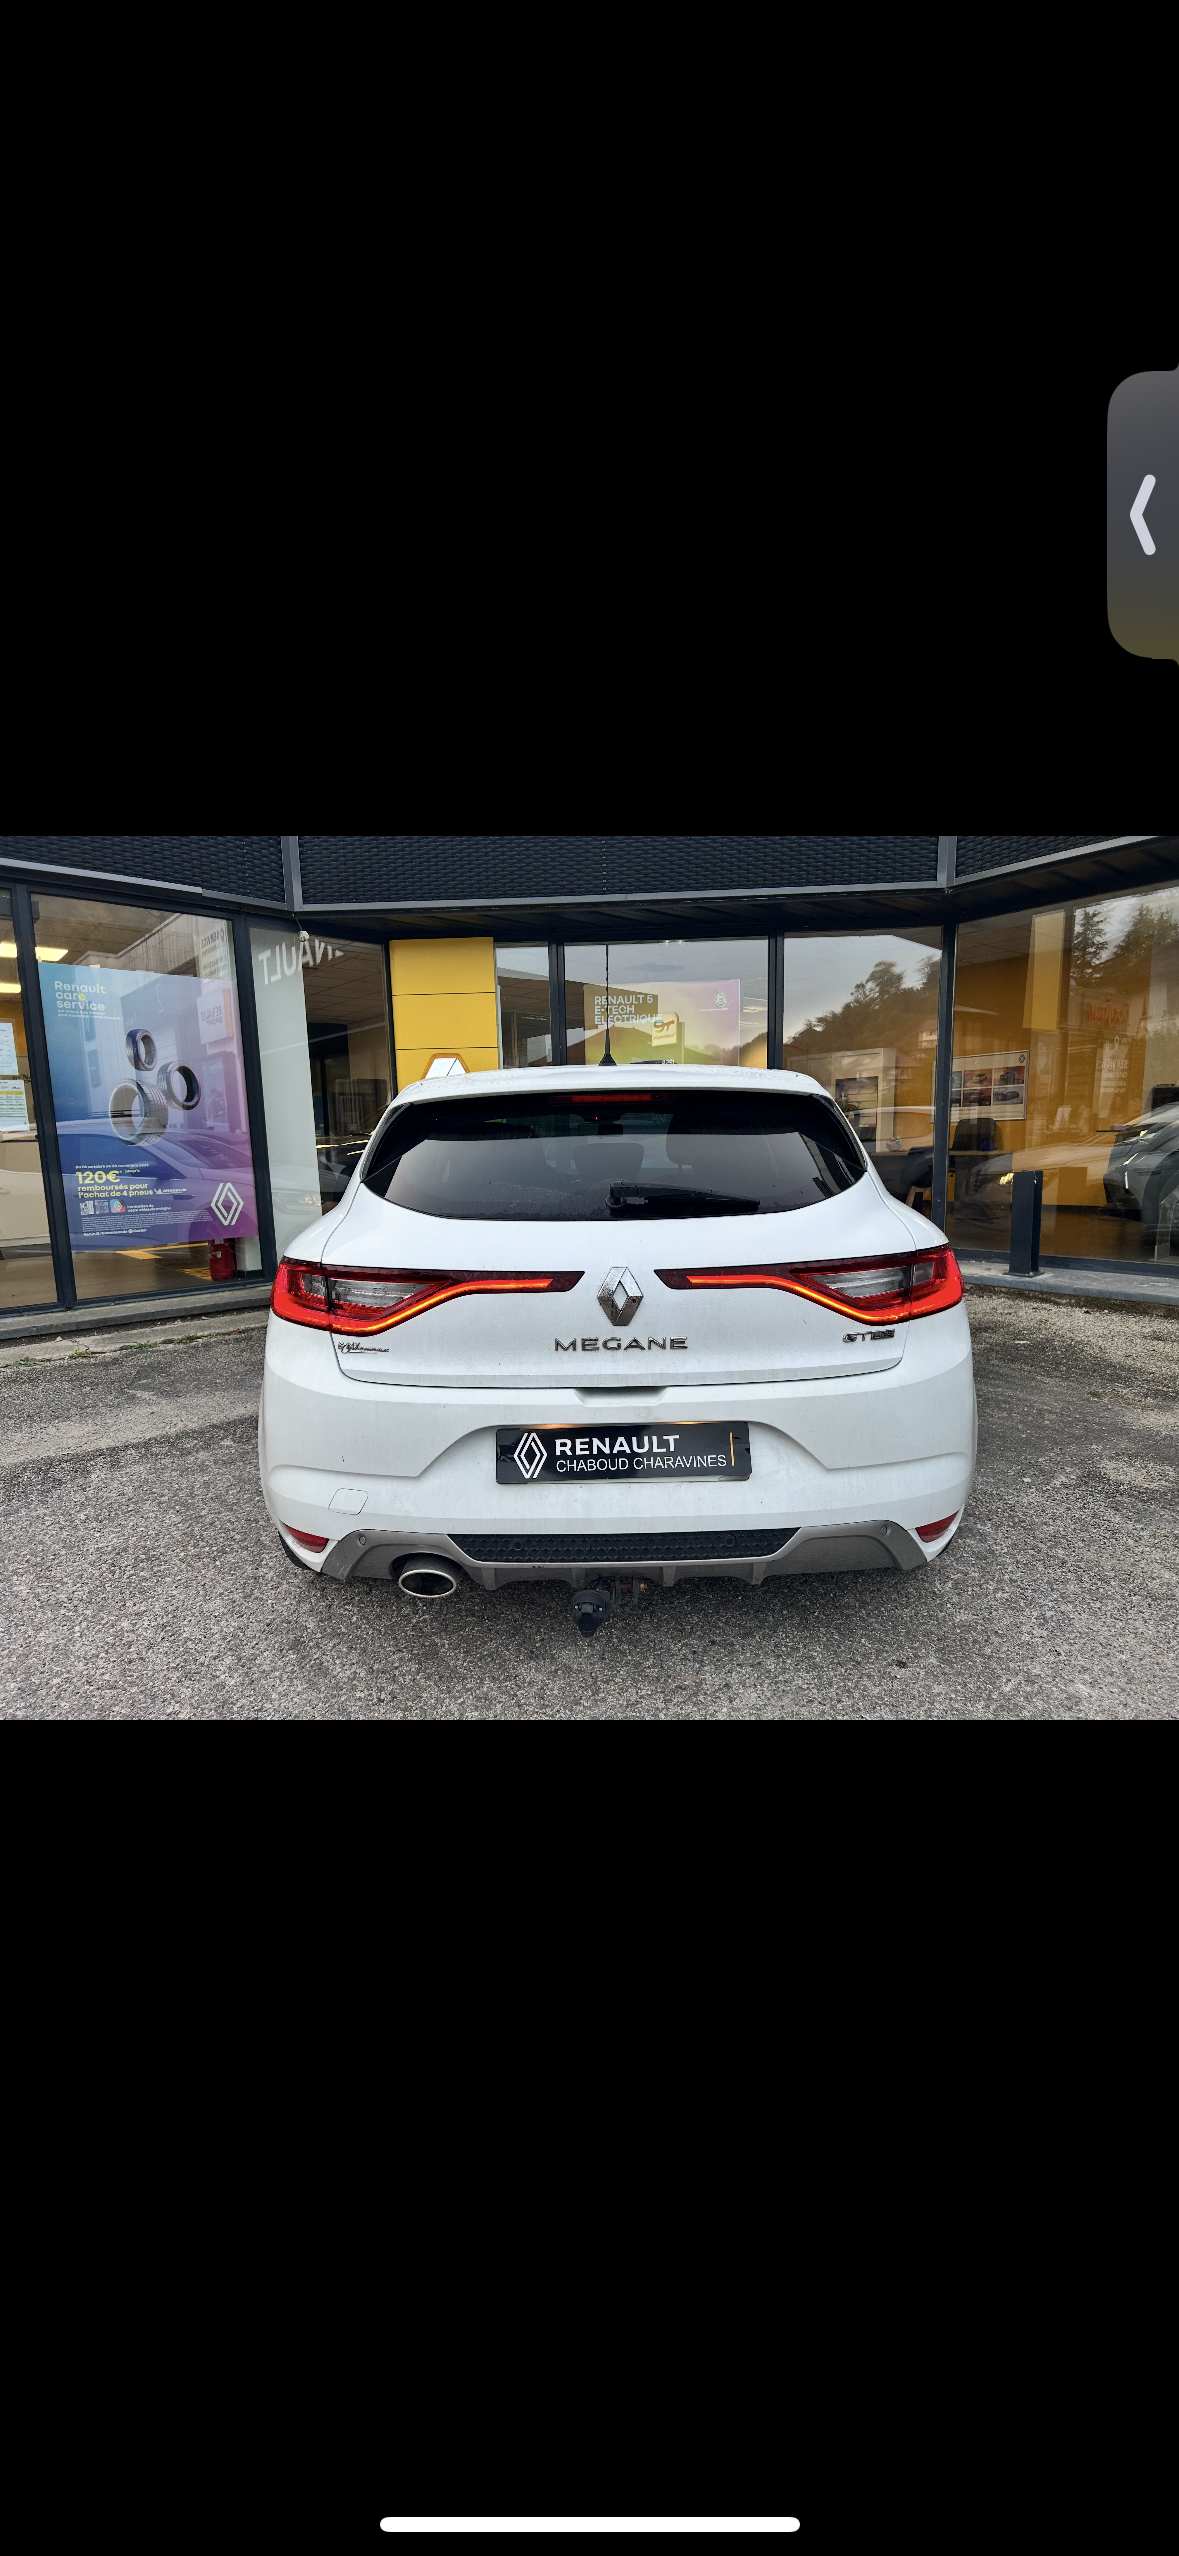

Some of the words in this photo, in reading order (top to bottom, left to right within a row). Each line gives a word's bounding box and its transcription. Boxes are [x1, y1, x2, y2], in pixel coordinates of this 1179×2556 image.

[54, 980, 106, 994] Renault
[55, 991, 86, 1001] care
[594, 994, 645, 1005] RENAULT
[646, 994, 654, 1004] 5
[56, 1000, 106, 1011] service
[594, 1005, 635, 1015] E-TECH
[77, 1183, 129, 1192] remboursés
[129, 1183, 149, 1191] pour
[78, 1190, 110, 1199] l'achat
[128, 1190, 154, 1198] pneus
[554, 1336, 688, 1352] MEGANE
[554, 1434, 680, 1456] RENAULT
[556, 1457, 629, 1473] CHABOUD
[633, 1454, 727, 1471] CHARAVINES
